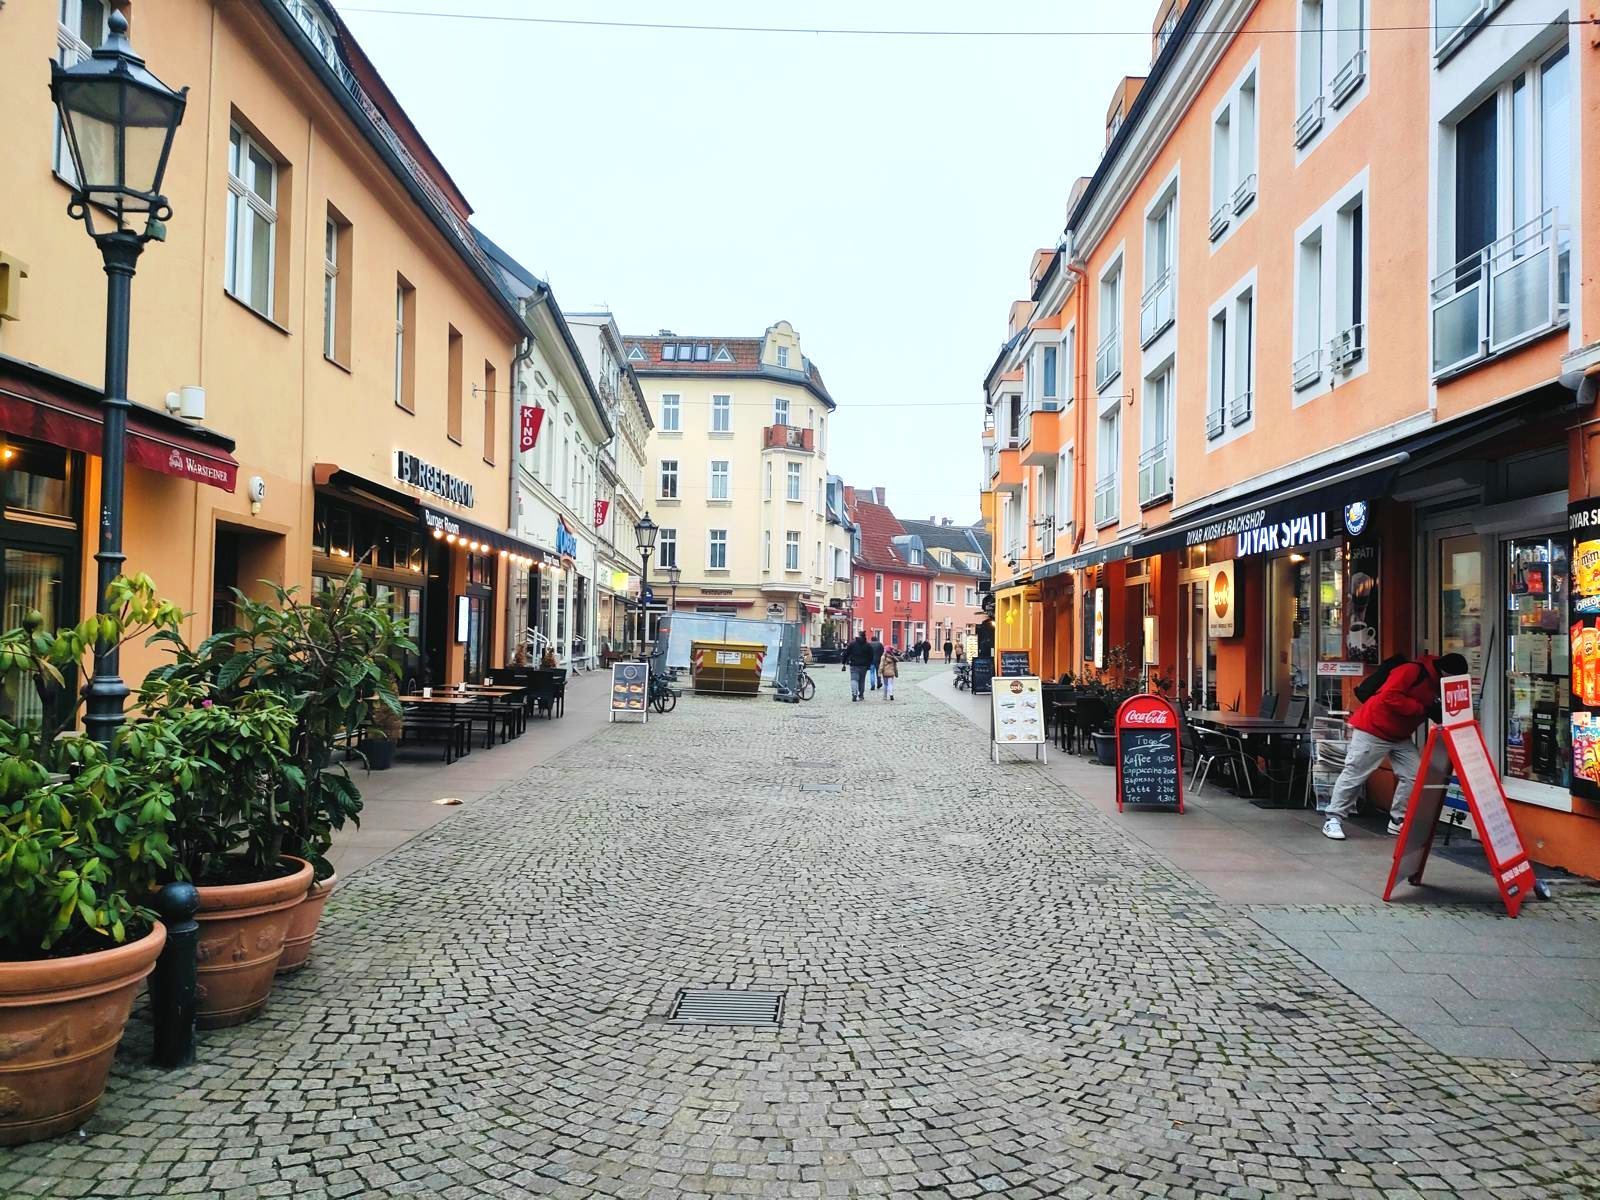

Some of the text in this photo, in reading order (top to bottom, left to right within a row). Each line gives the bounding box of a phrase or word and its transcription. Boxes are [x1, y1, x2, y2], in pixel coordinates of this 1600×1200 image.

[523, 408, 534, 446] KINO
[425, 509, 460, 535] Burger Room
[1186, 527, 1204, 546] DIYAR
[1203, 522, 1222, 541] KIOSK
[1226, 509, 1266, 535] BACKSHOP
[1236, 523, 1280, 557] DIYAR
[1124, 753, 1151, 767] Kaffee
[1125, 785, 1151, 794] Latte
[1126, 794, 1141, 802] Tee
